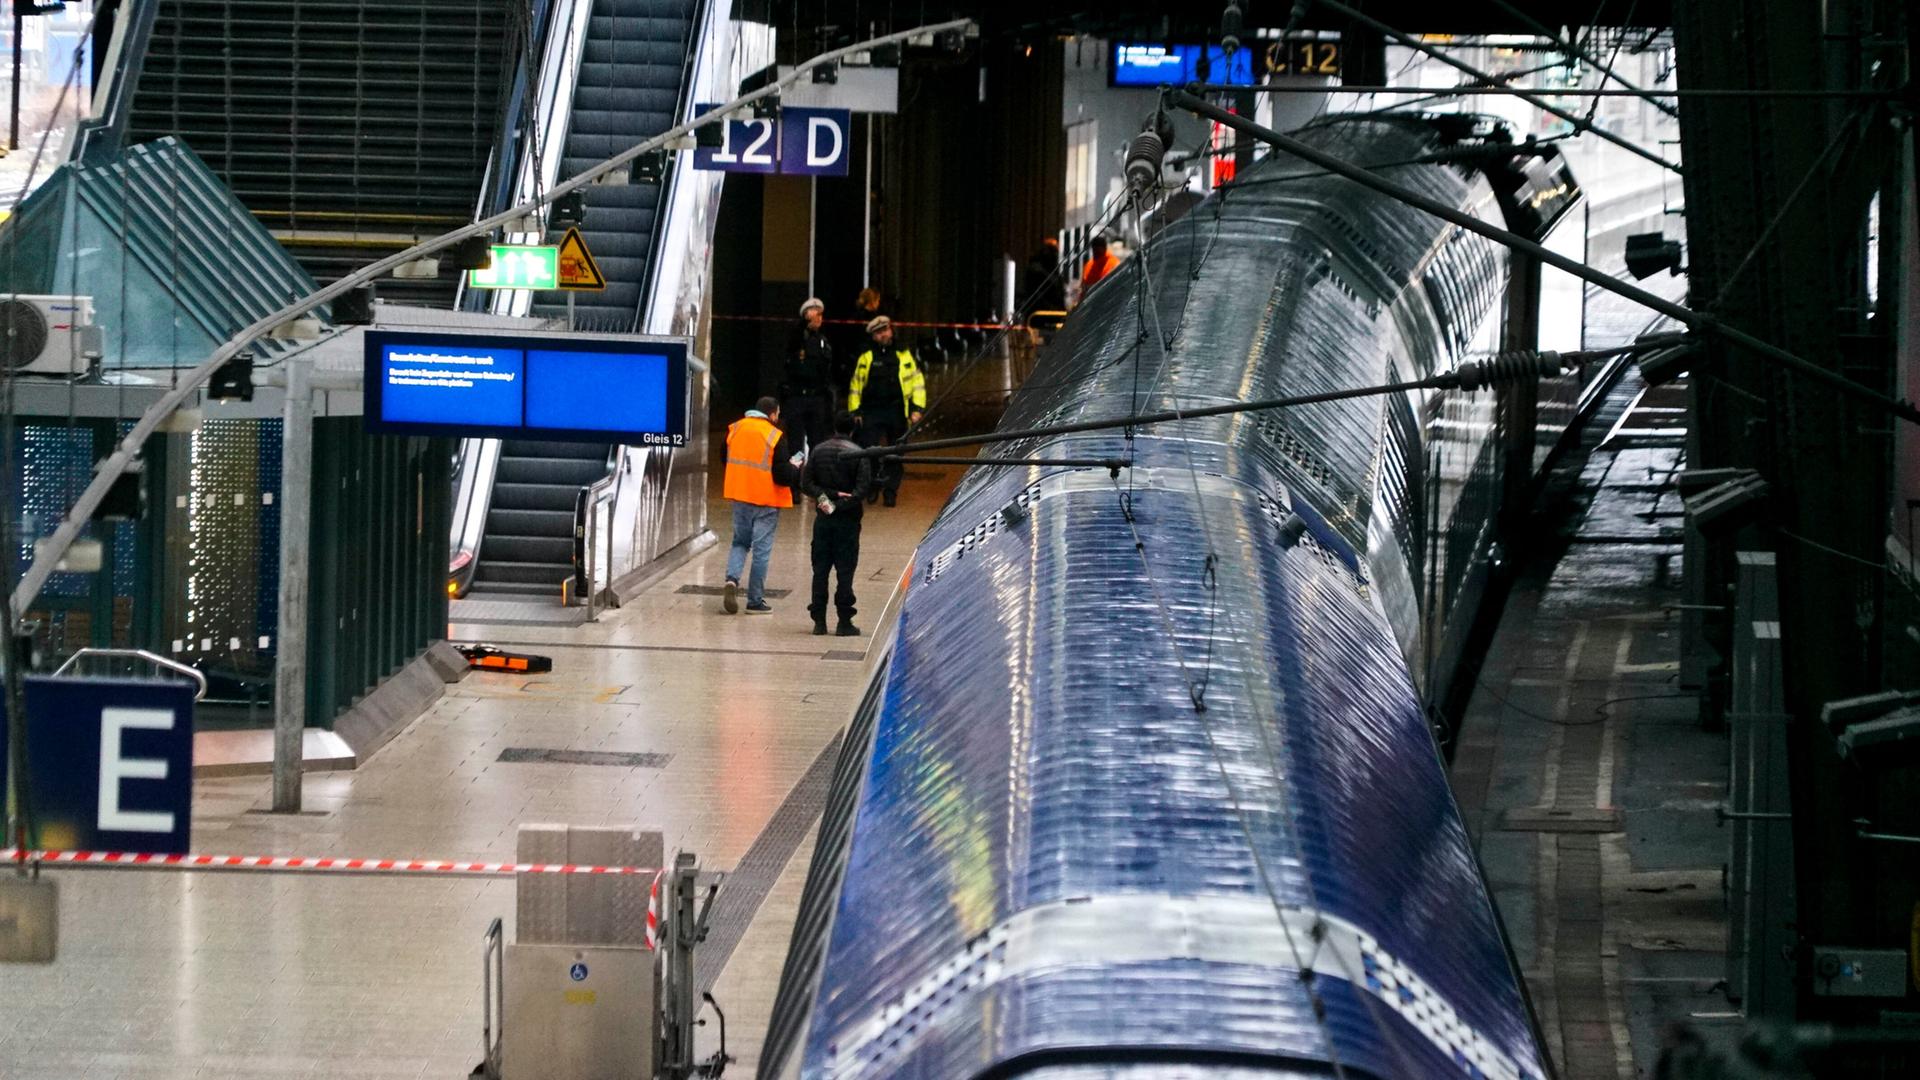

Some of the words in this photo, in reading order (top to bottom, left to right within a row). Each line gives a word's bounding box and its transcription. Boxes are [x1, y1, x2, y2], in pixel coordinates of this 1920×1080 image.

[1301, 42, 1338, 73] 12
[711, 117, 772, 164] 12
[806, 117, 843, 166] D
[643, 432, 670, 445] Gleis
[672, 434, 683, 445] 12
[97, 706, 175, 833] E
